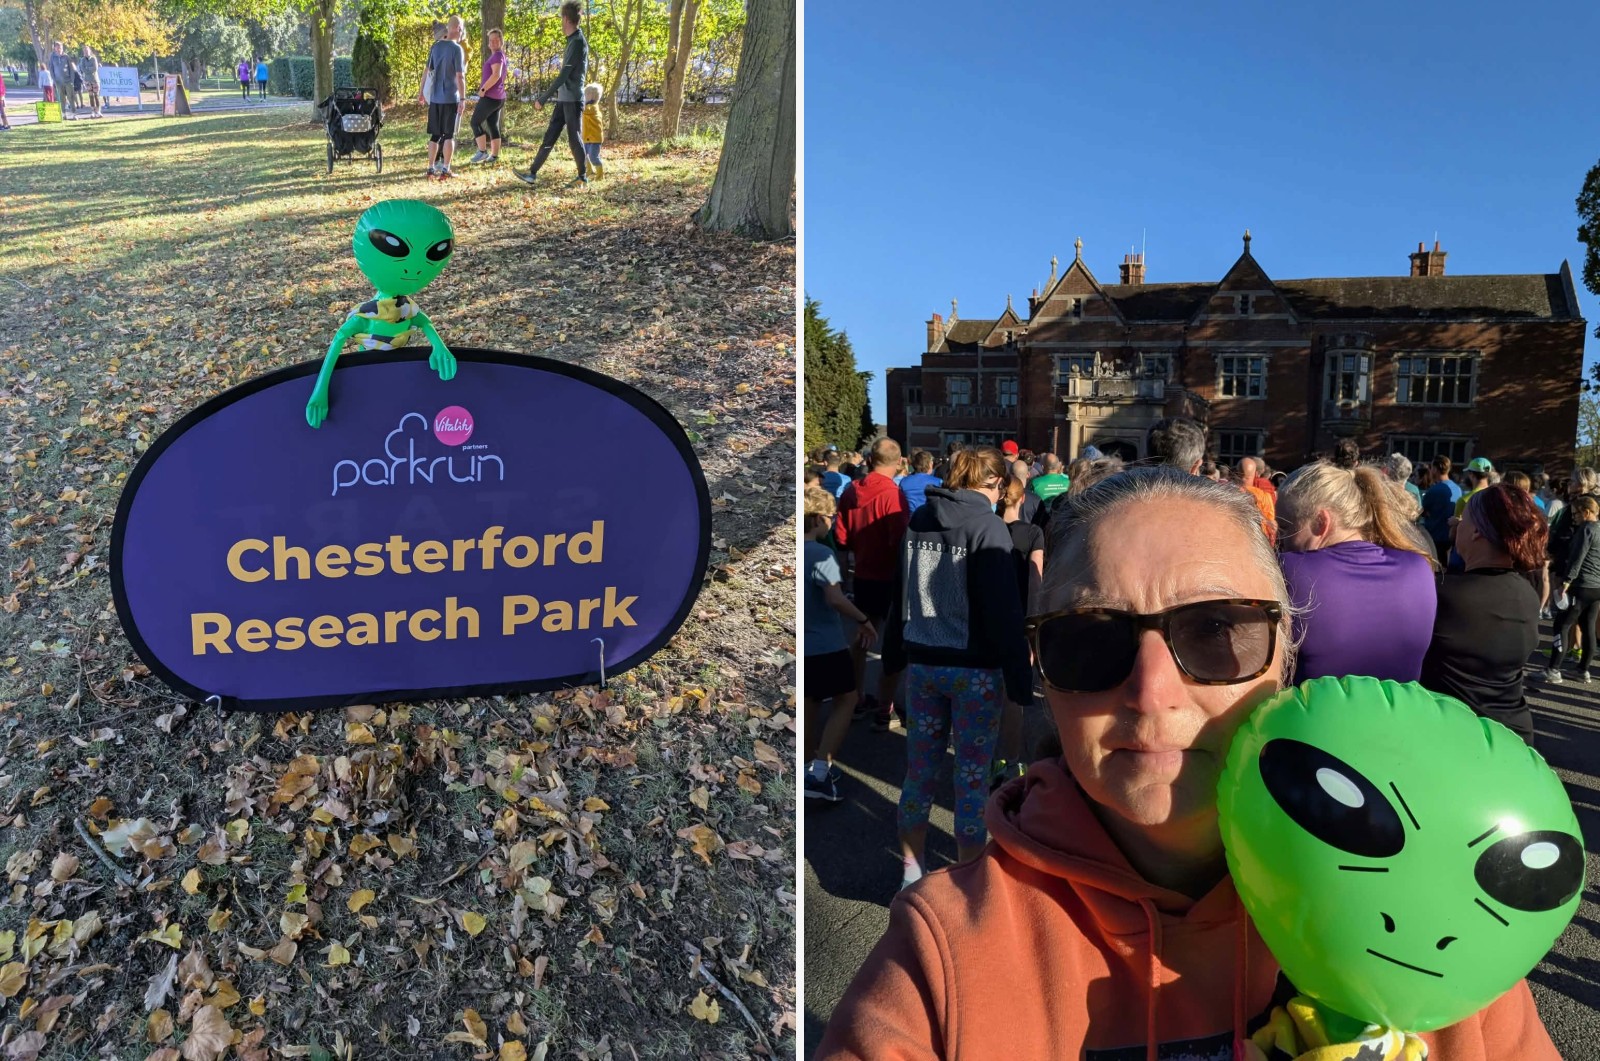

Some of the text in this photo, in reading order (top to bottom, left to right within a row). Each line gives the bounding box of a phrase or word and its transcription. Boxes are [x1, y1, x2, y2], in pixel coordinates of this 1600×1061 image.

[101, 78, 133, 86] NUCLEUS
[435, 415, 473, 436] Vitality
[462, 444, 489, 452] partners
[331, 436, 505, 497] parkrun
[227, 520, 604, 583] Chesterford
[907, 540, 933, 550] CASS
[948, 545, 967, 556] 023
[191, 586, 638, 655] Research Park
